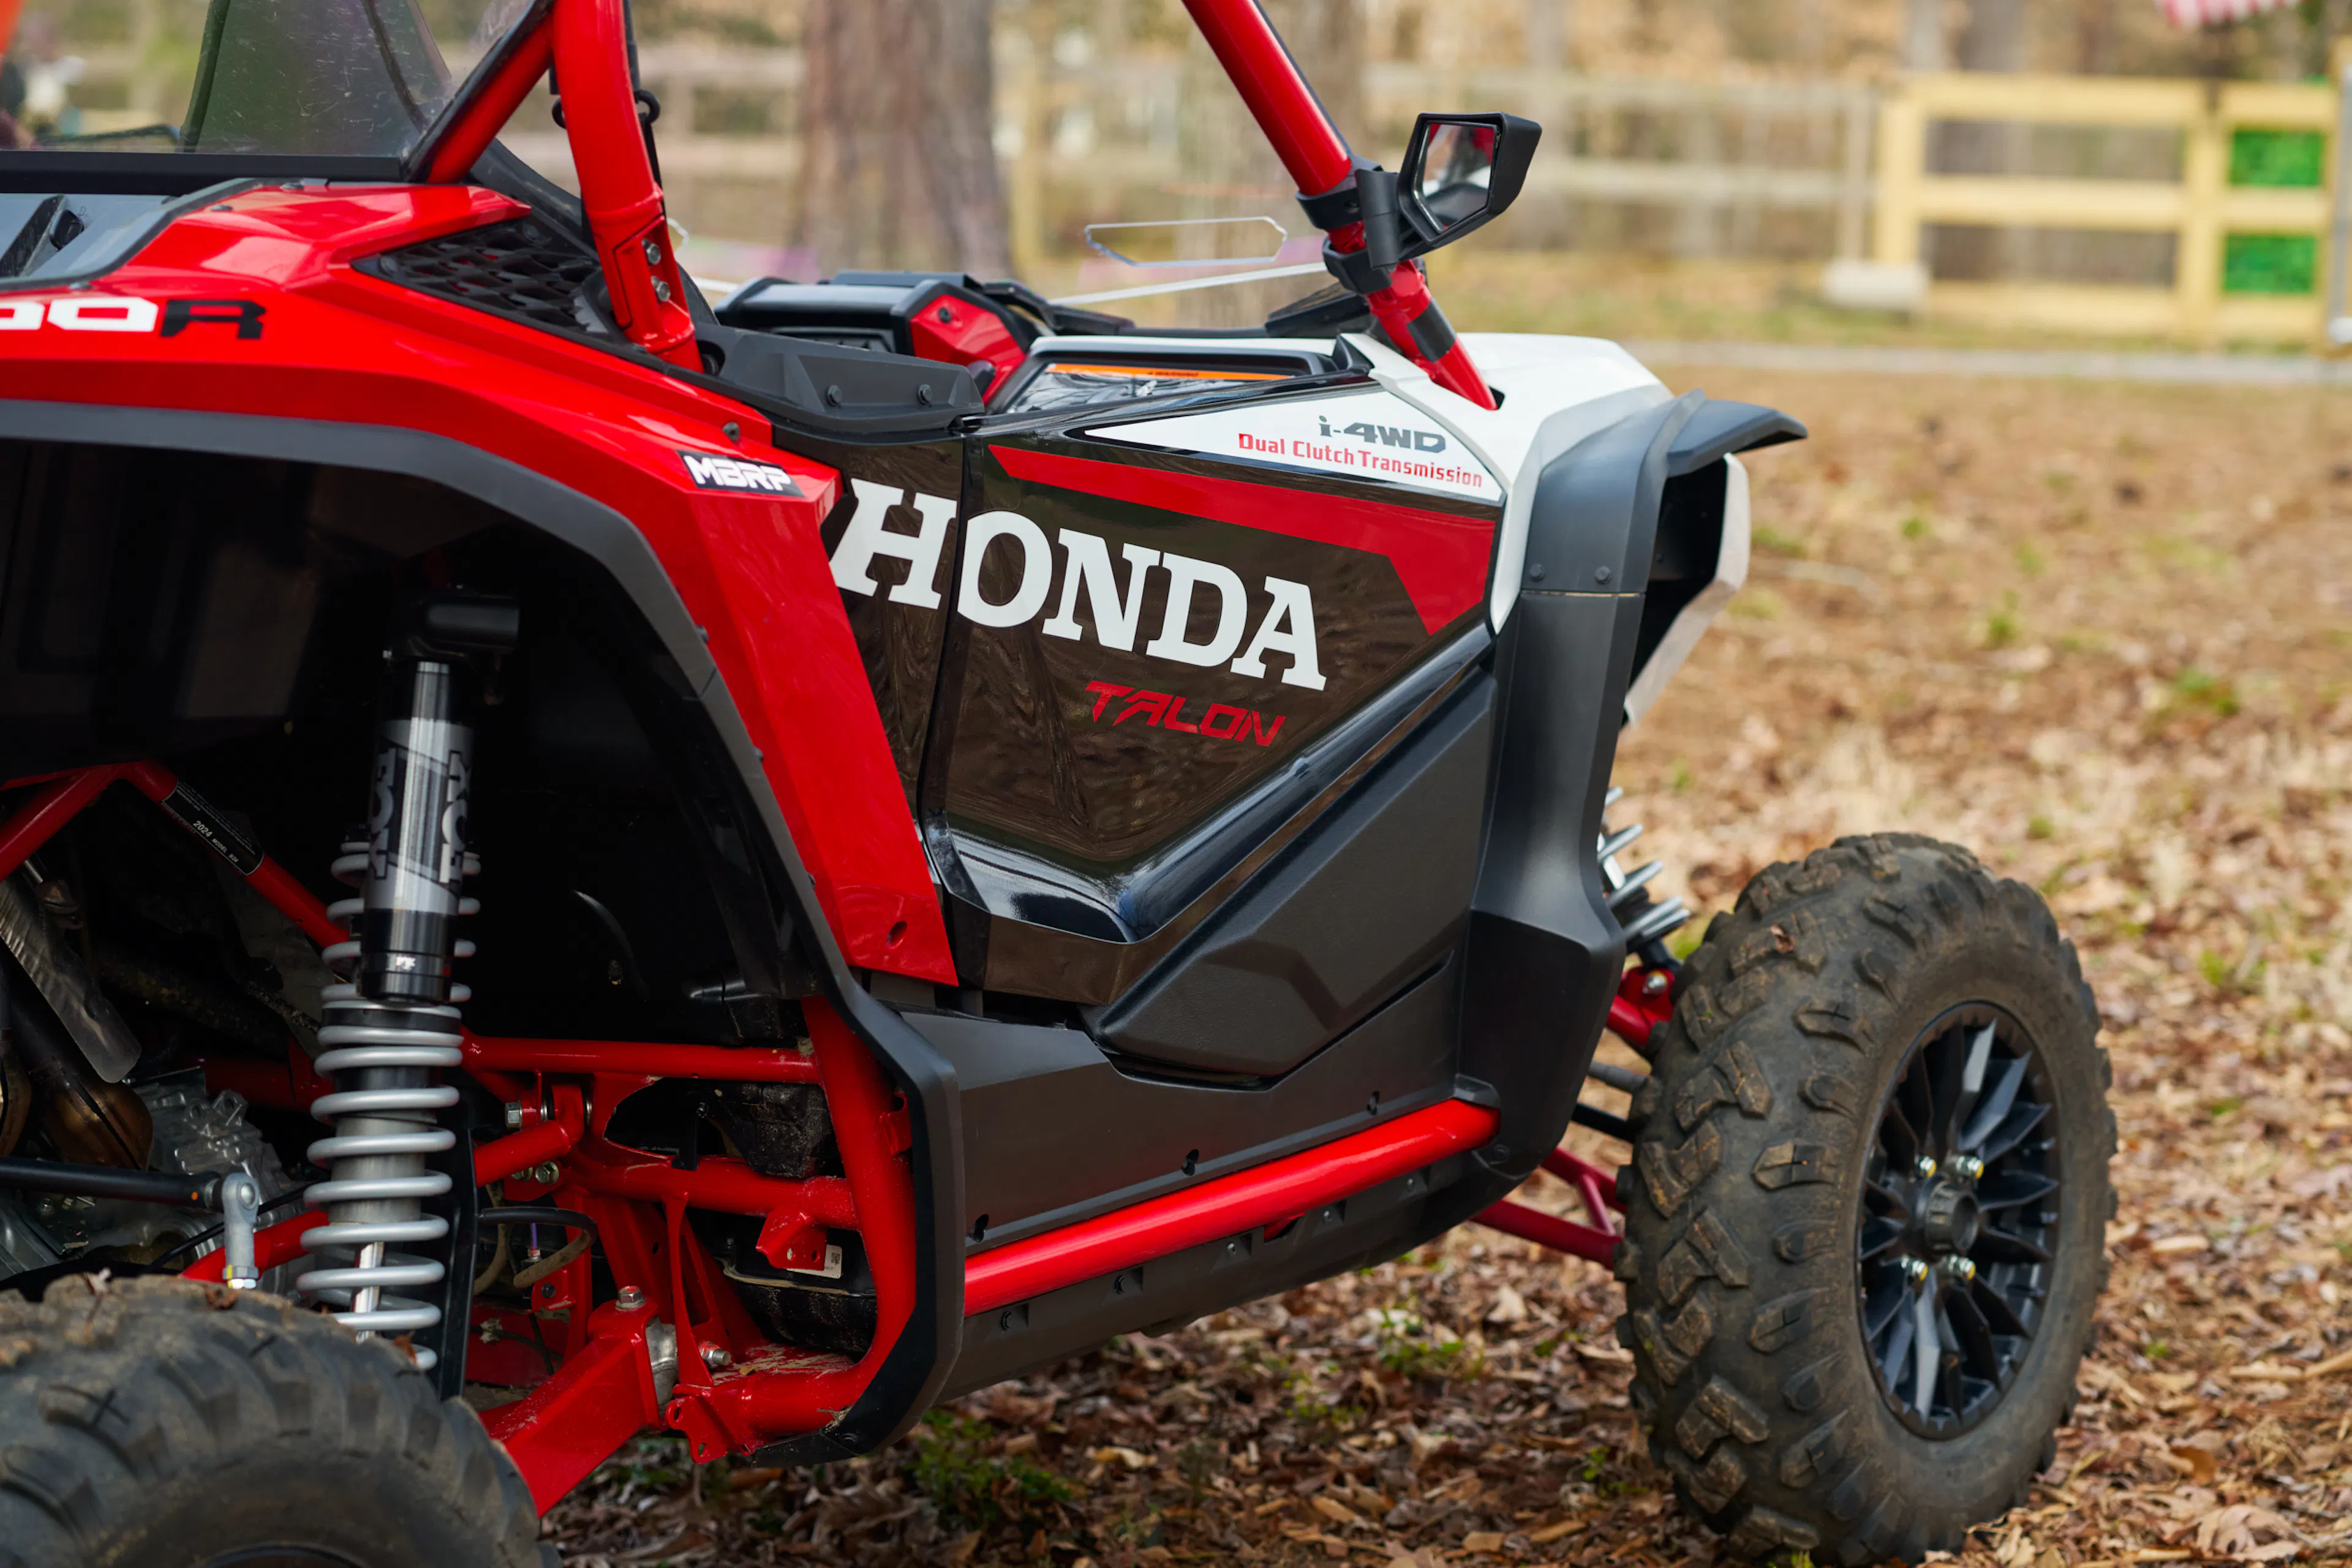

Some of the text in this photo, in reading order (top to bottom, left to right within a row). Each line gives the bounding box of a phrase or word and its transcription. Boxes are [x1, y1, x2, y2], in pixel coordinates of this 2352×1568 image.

[1319, 415, 1446, 453] i-4WD
[684, 455, 792, 491] MBRP
[1238, 433, 1483, 488] Dual Clutch Transmission
[829, 478, 1326, 690] HONDA
[1085, 680, 1286, 747] TALON
[193, 820, 213, 837] 2024
